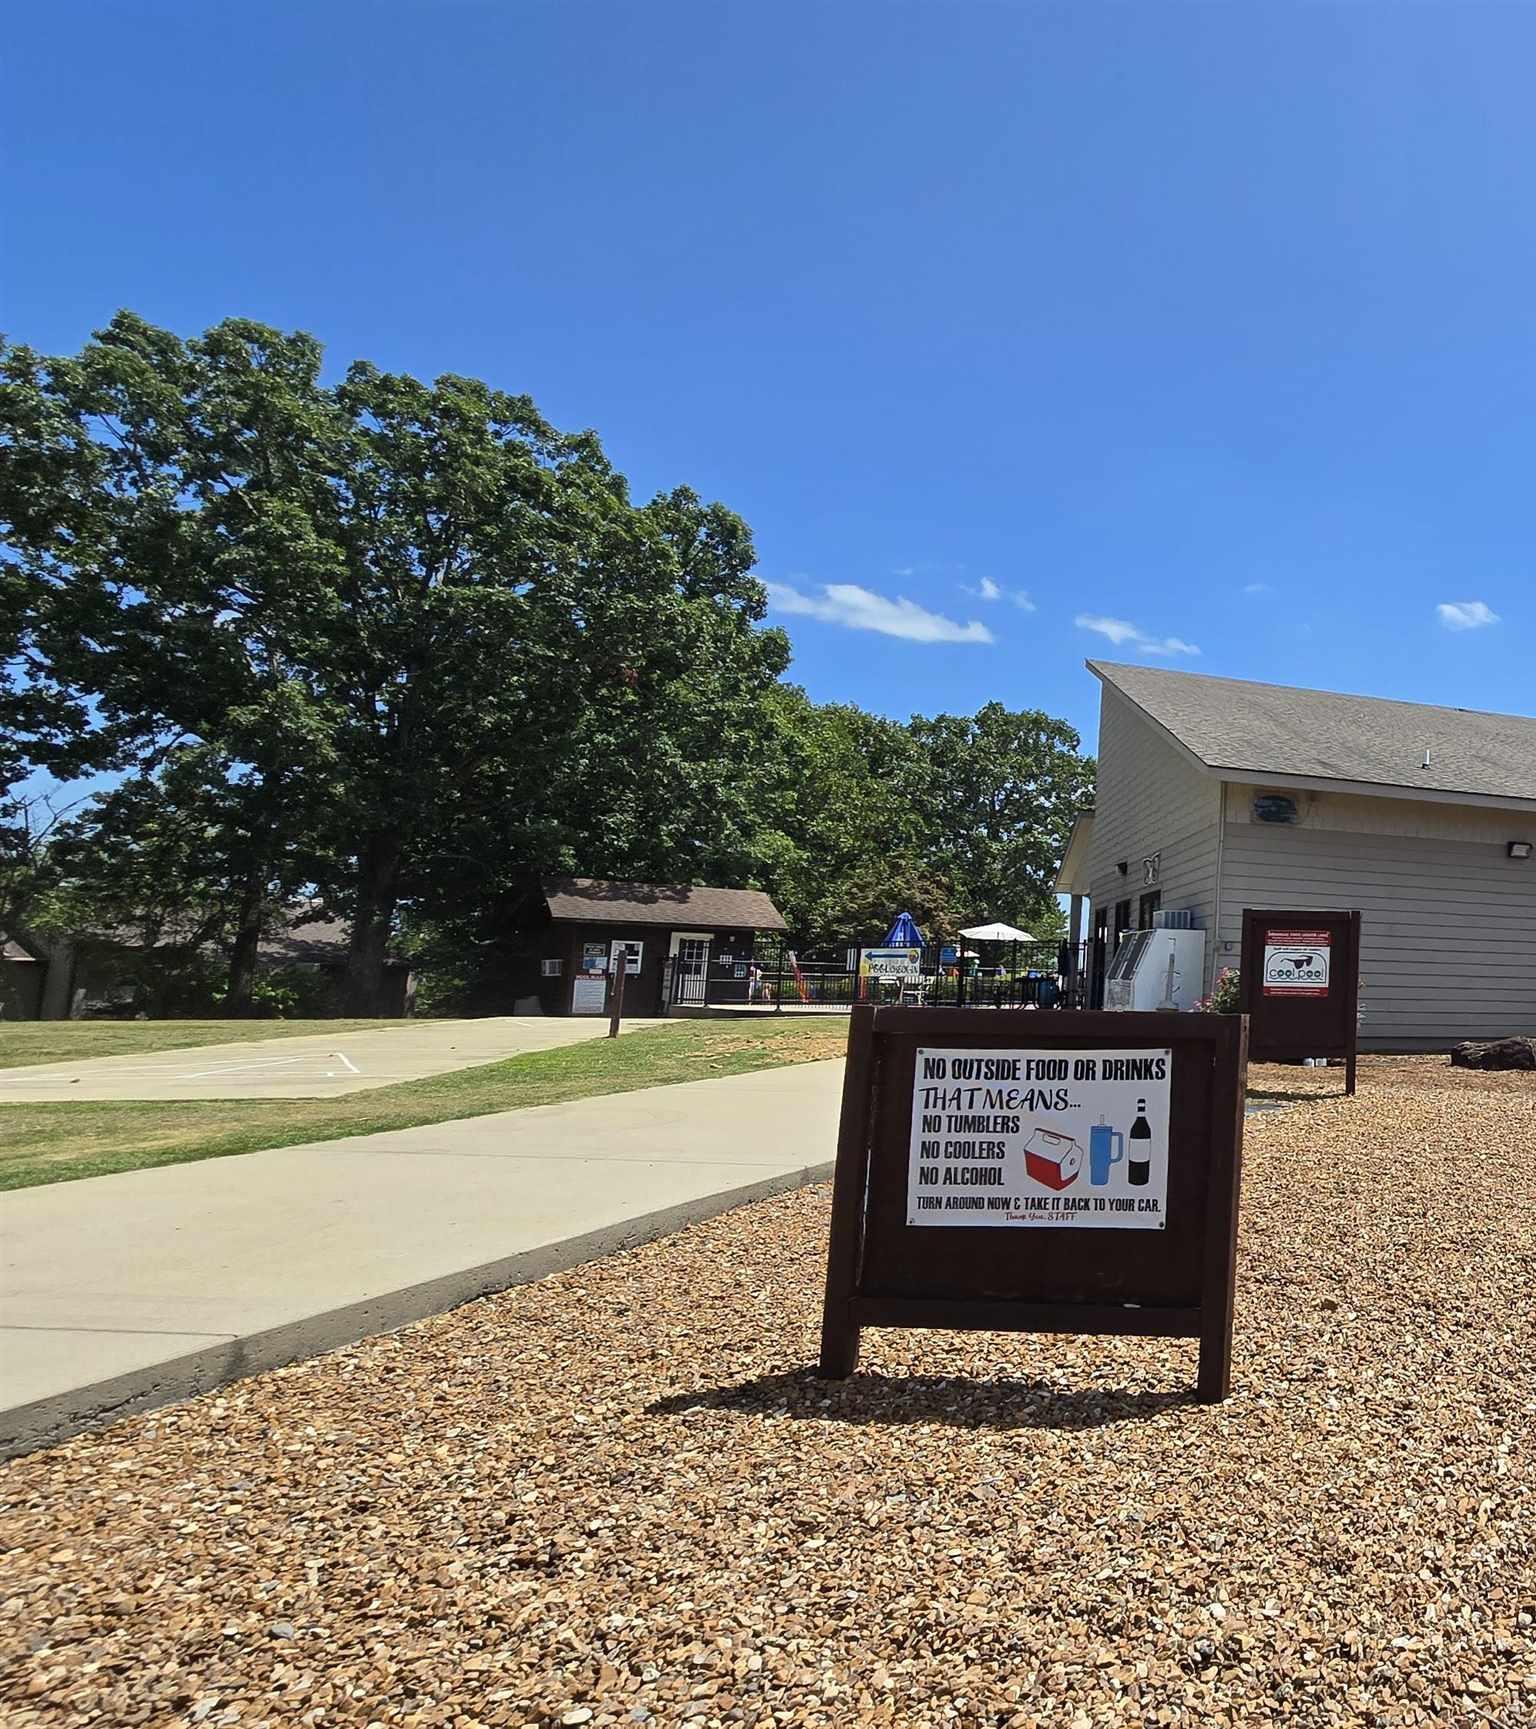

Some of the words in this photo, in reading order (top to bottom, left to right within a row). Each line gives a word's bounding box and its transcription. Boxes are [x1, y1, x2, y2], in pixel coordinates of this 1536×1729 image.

[1269, 968, 1295, 978] cool
[1298, 969, 1324, 981] pool
[923, 1058, 946, 1080] NO
[952, 1058, 1021, 1081] OUTSIDE
[1026, 1058, 1069, 1081] FOOD
[1073, 1058, 1096, 1081] OR
[1102, 1058, 1166, 1081] DRINKS
[918, 1087, 983, 1111] THAT
[983, 1088, 1081, 1111] MEANS...
[922, 1115, 942, 1133] NO
[945, 1115, 1020, 1134] TUMBLERS
[920, 1141, 940, 1159] NO
[944, 1141, 1005, 1160] COOLERS
[919, 1166, 939, 1185] NO
[942, 1167, 1005, 1186] ALCOHOL
[917, 1196, 942, 1210] TURN
[944, 1197, 985, 1210] AROUND
[987, 1197, 1012, 1210] NOW
[1014, 1197, 1021, 1210] &
[1024, 1198, 1049, 1211] TAKE
[1051, 1198, 1061, 1211] IT
[1063, 1198, 1090, 1211] BACK
[1092, 1198, 1105, 1212] TO
[1108, 1198, 1135, 1212] YOUR
[1138, 1198, 1161, 1212] CAR.
